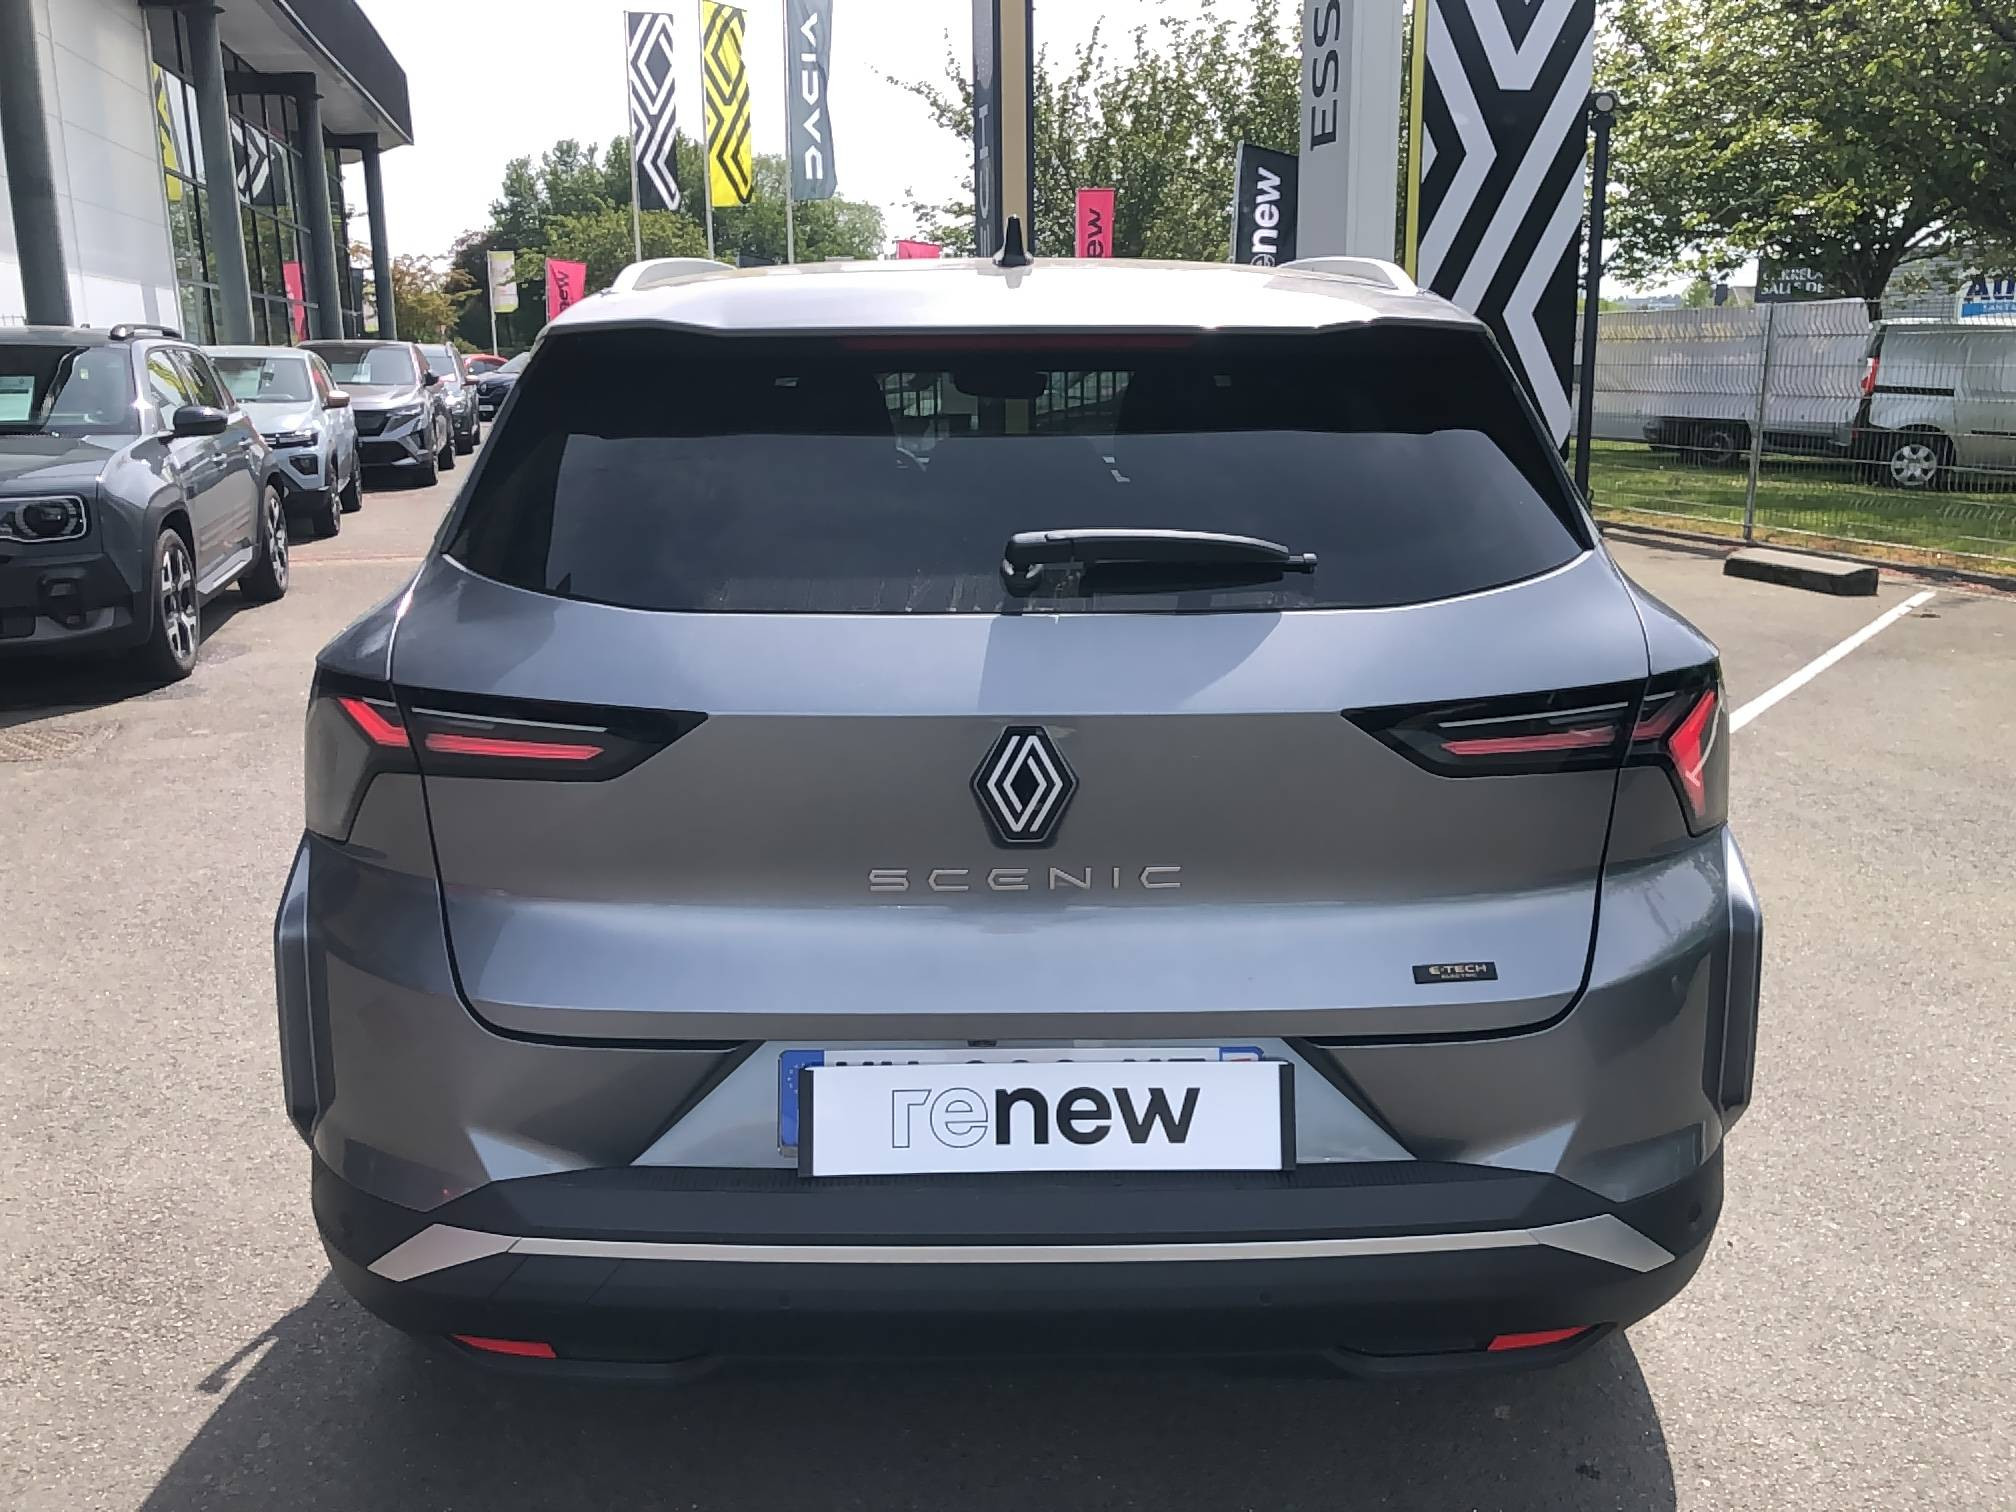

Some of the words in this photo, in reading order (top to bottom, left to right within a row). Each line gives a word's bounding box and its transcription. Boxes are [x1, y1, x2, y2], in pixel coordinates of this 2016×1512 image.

[800, 12, 823, 179] DACIA
[868, 866, 1182, 891] SCENIC
[1428, 964, 1487, 975] E-TECH
[891, 1086, 1201, 1148] renew
